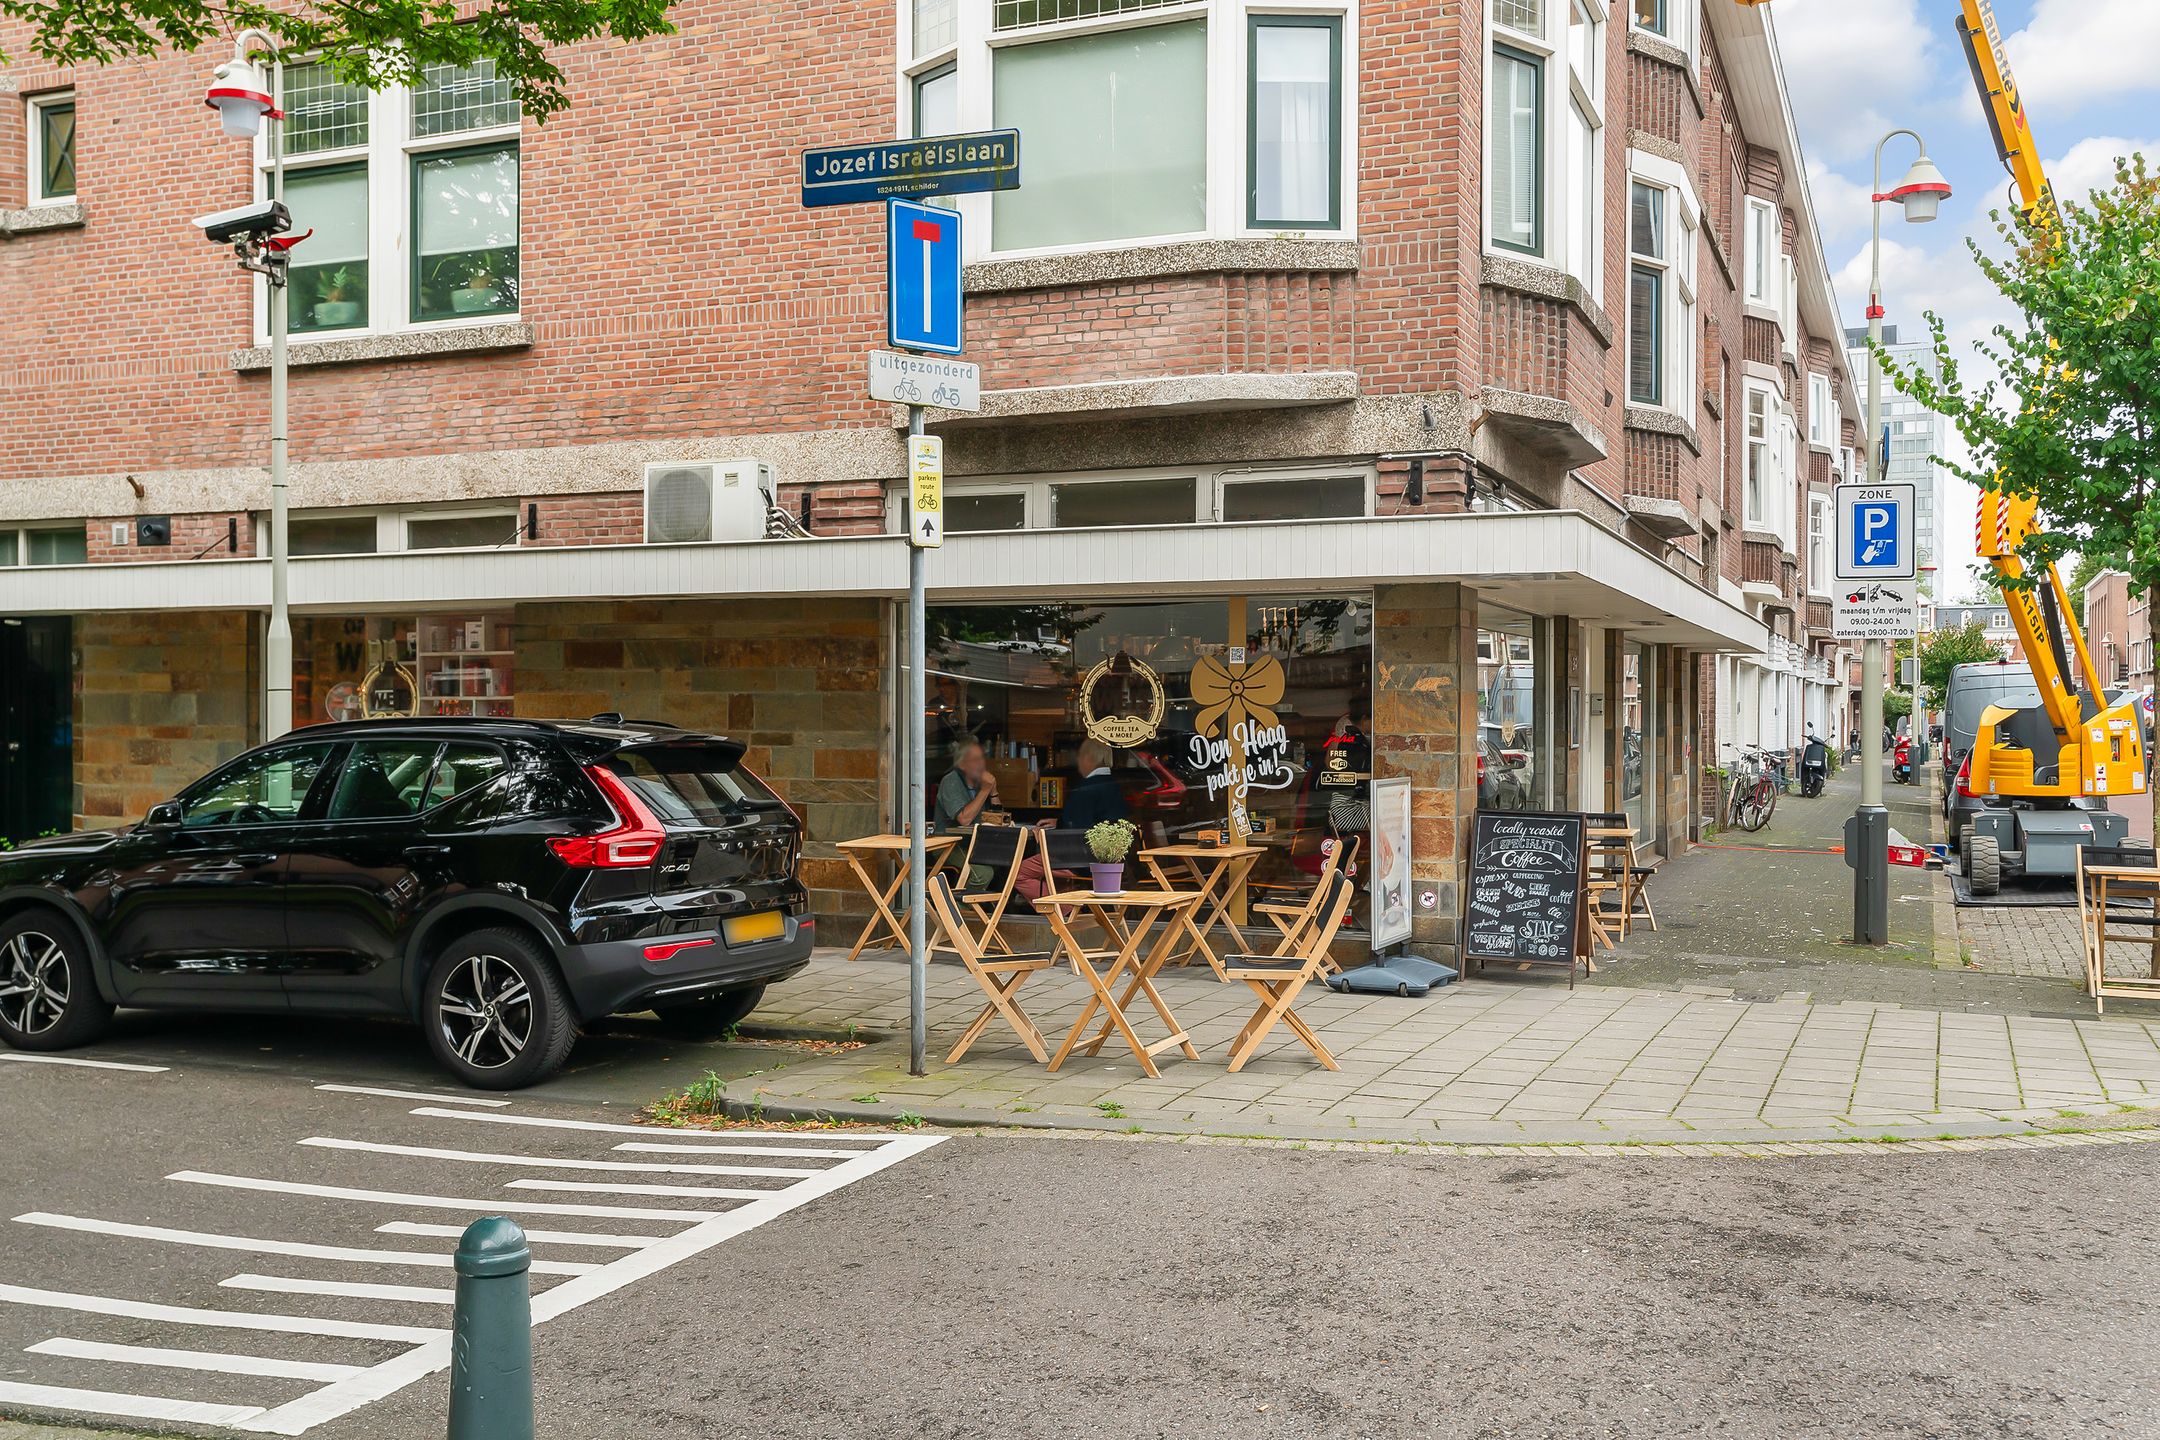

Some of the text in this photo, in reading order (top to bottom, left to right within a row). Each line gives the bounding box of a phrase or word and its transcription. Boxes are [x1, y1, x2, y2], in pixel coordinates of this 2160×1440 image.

[1978, 0, 2013, 93] Haulotte
[815, 142, 1005, 177] Jozef Israëlslaan
[910, 181, 939, 192] schilder
[879, 355, 974, 379] uitgezonderd
[918, 474, 937, 482] parken
[1858, 489, 1893, 500] ZONE
[1864, 508, 1890, 541] P
[1840, 606, 1912, 615] maandag t/m vrijdag
[1850, 618, 1894, 626] 09.00-24.00
[1836, 629, 1866, 637] zaterdag
[1868, 628, 1908, 636] 09.00-17.00
[1187, 719, 1291, 769] Den Haag
[1323, 735, 1356, 748] jura
[1206, 761, 1240, 801] pakt
[1258, 749, 1279, 775] in!
[1492, 820, 1567, 840] locally roasted
[1499, 837, 1556, 852] SPECIALTY
[1501, 850, 1553, 868] Coffee
[660, 863, 691, 874] XC40
[1475, 872, 1509, 887] espresso
[1476, 895, 1500, 903] SOUP
[1520, 919, 1554, 938] STAY
